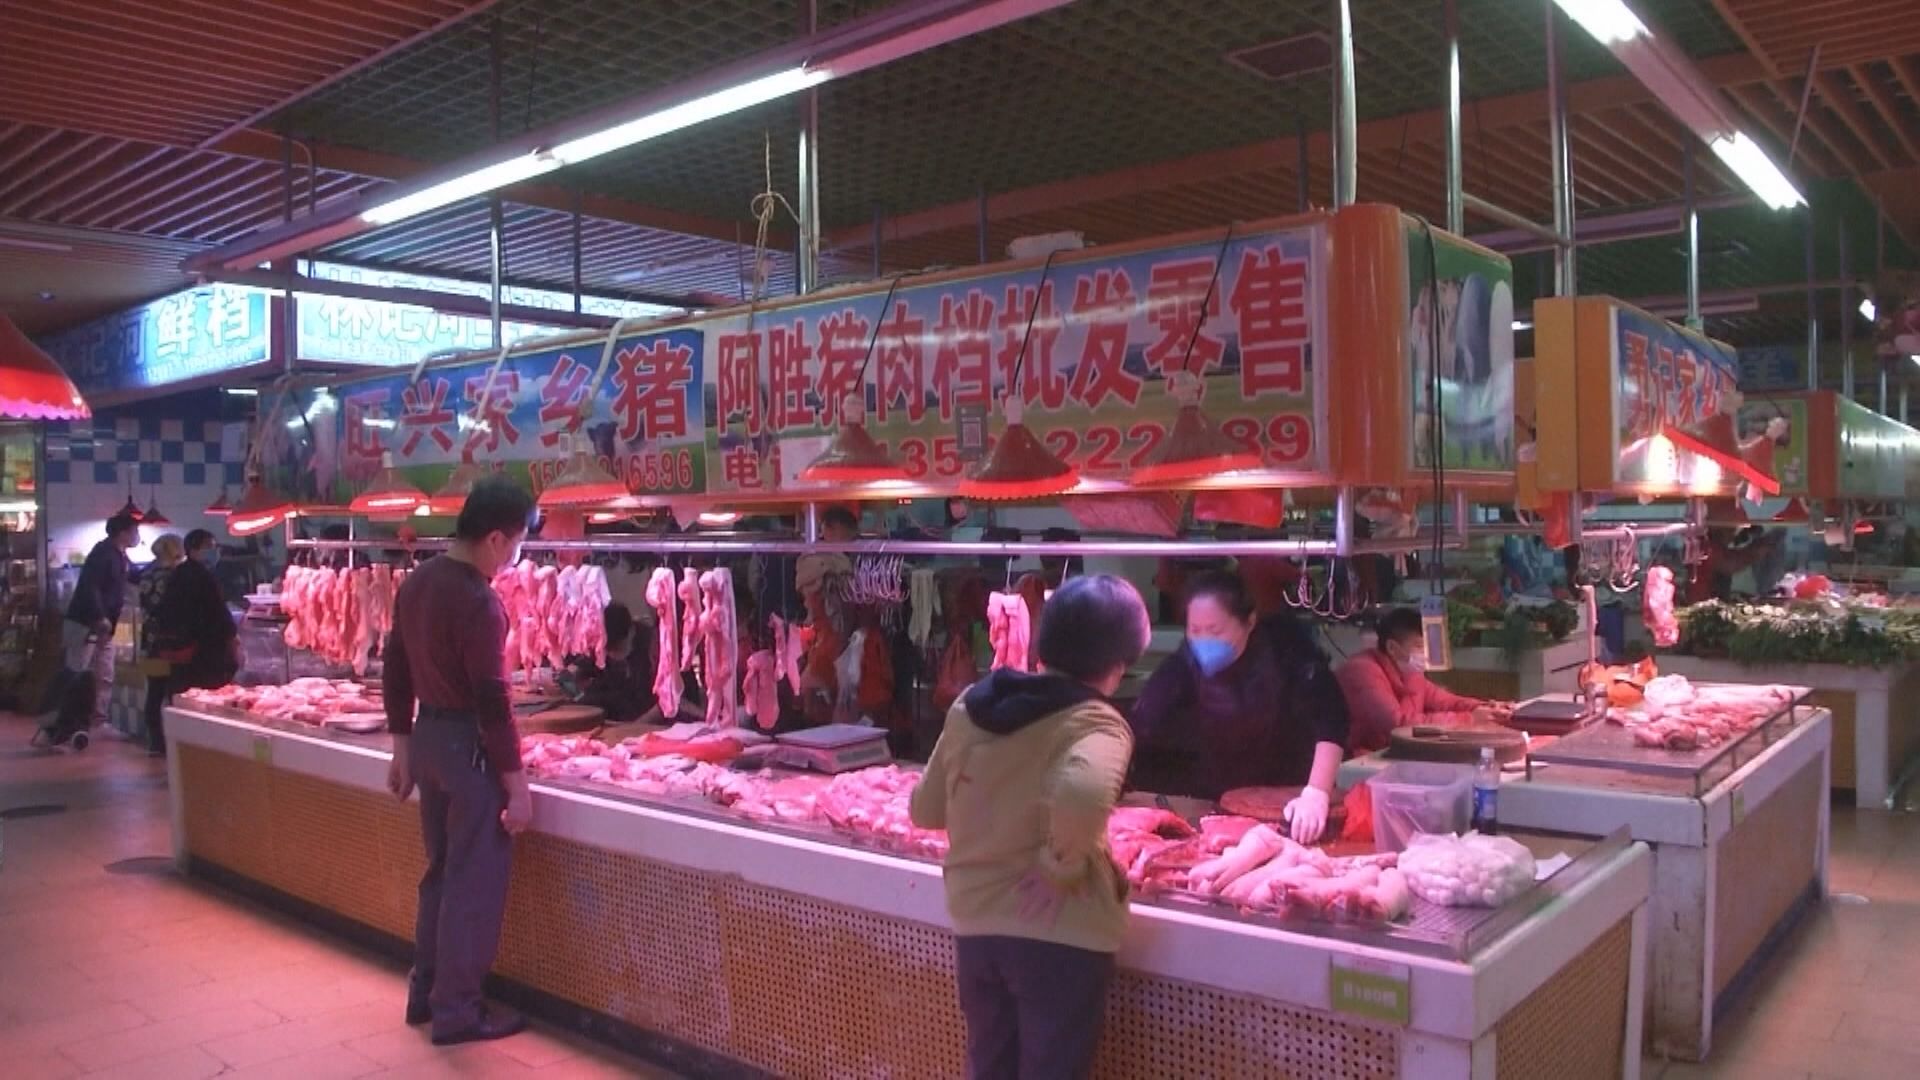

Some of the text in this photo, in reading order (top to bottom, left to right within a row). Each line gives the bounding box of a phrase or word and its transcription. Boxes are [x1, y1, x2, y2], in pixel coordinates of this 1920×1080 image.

[344, 339, 694, 459] 旺兴家乡猪
